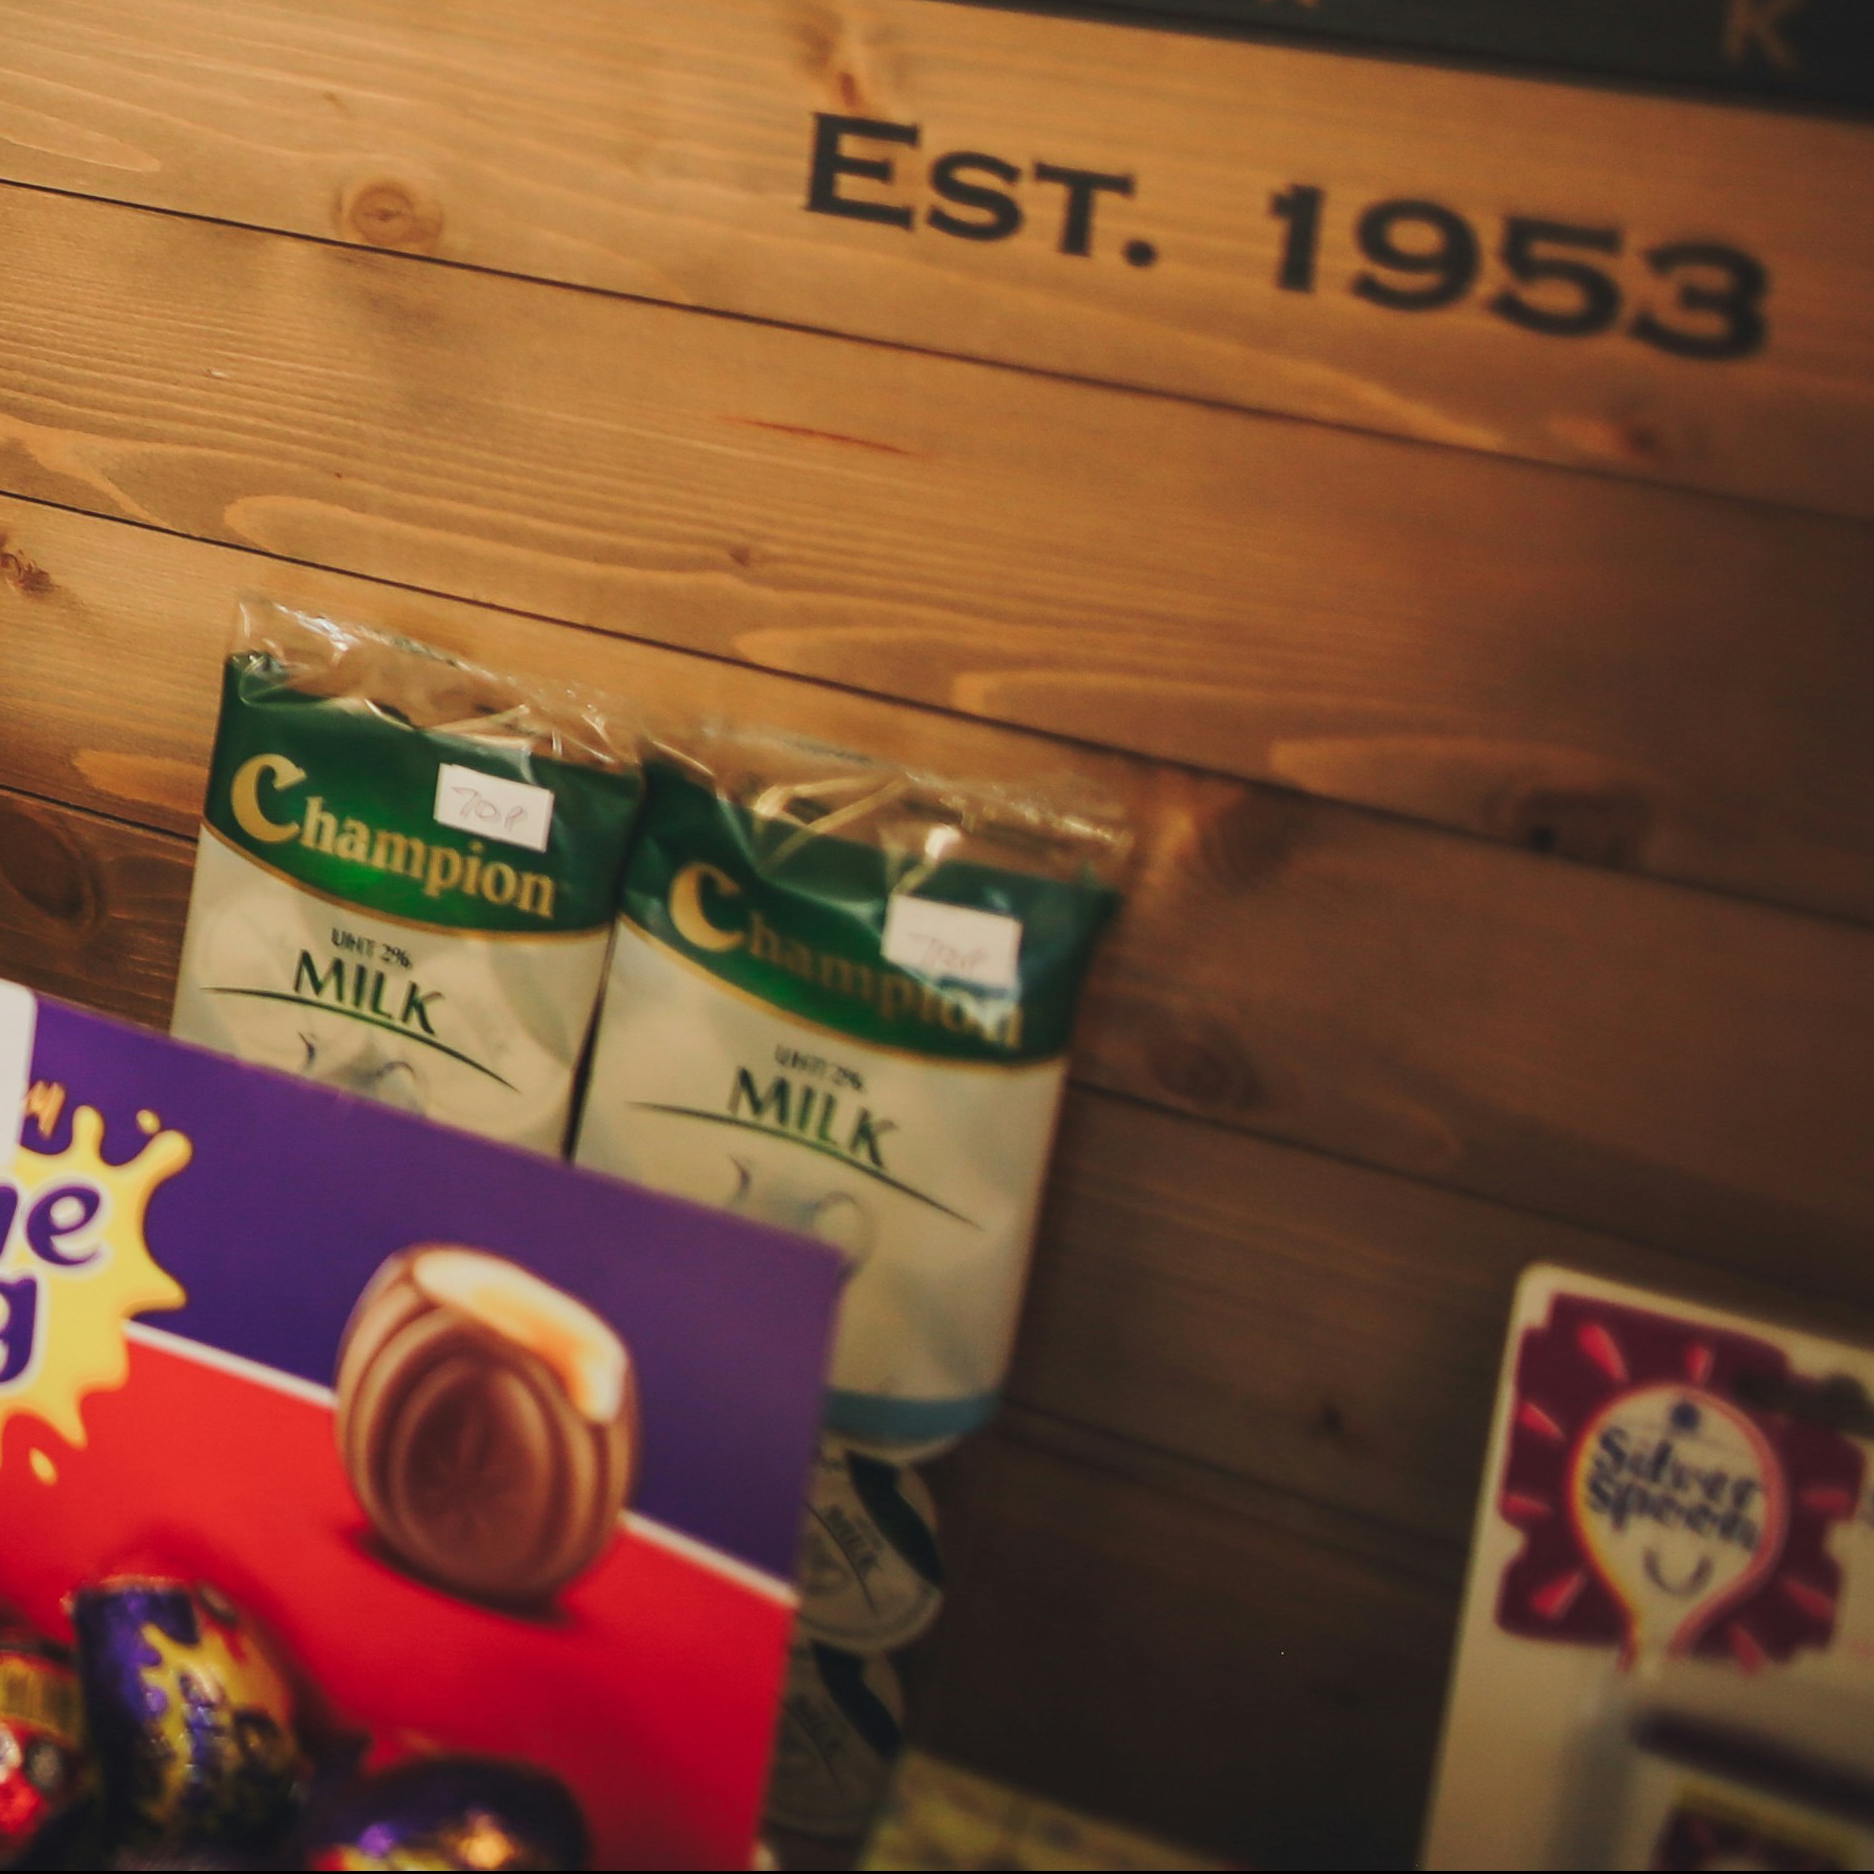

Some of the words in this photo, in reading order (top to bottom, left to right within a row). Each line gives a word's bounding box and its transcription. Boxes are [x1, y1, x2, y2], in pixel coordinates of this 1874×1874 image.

[1266, 180, 1770, 366] 1953
[230, 752, 556, 919] Champion
[294, 951, 447, 1036] MILK
[727, 1066, 895, 1172] MILK
